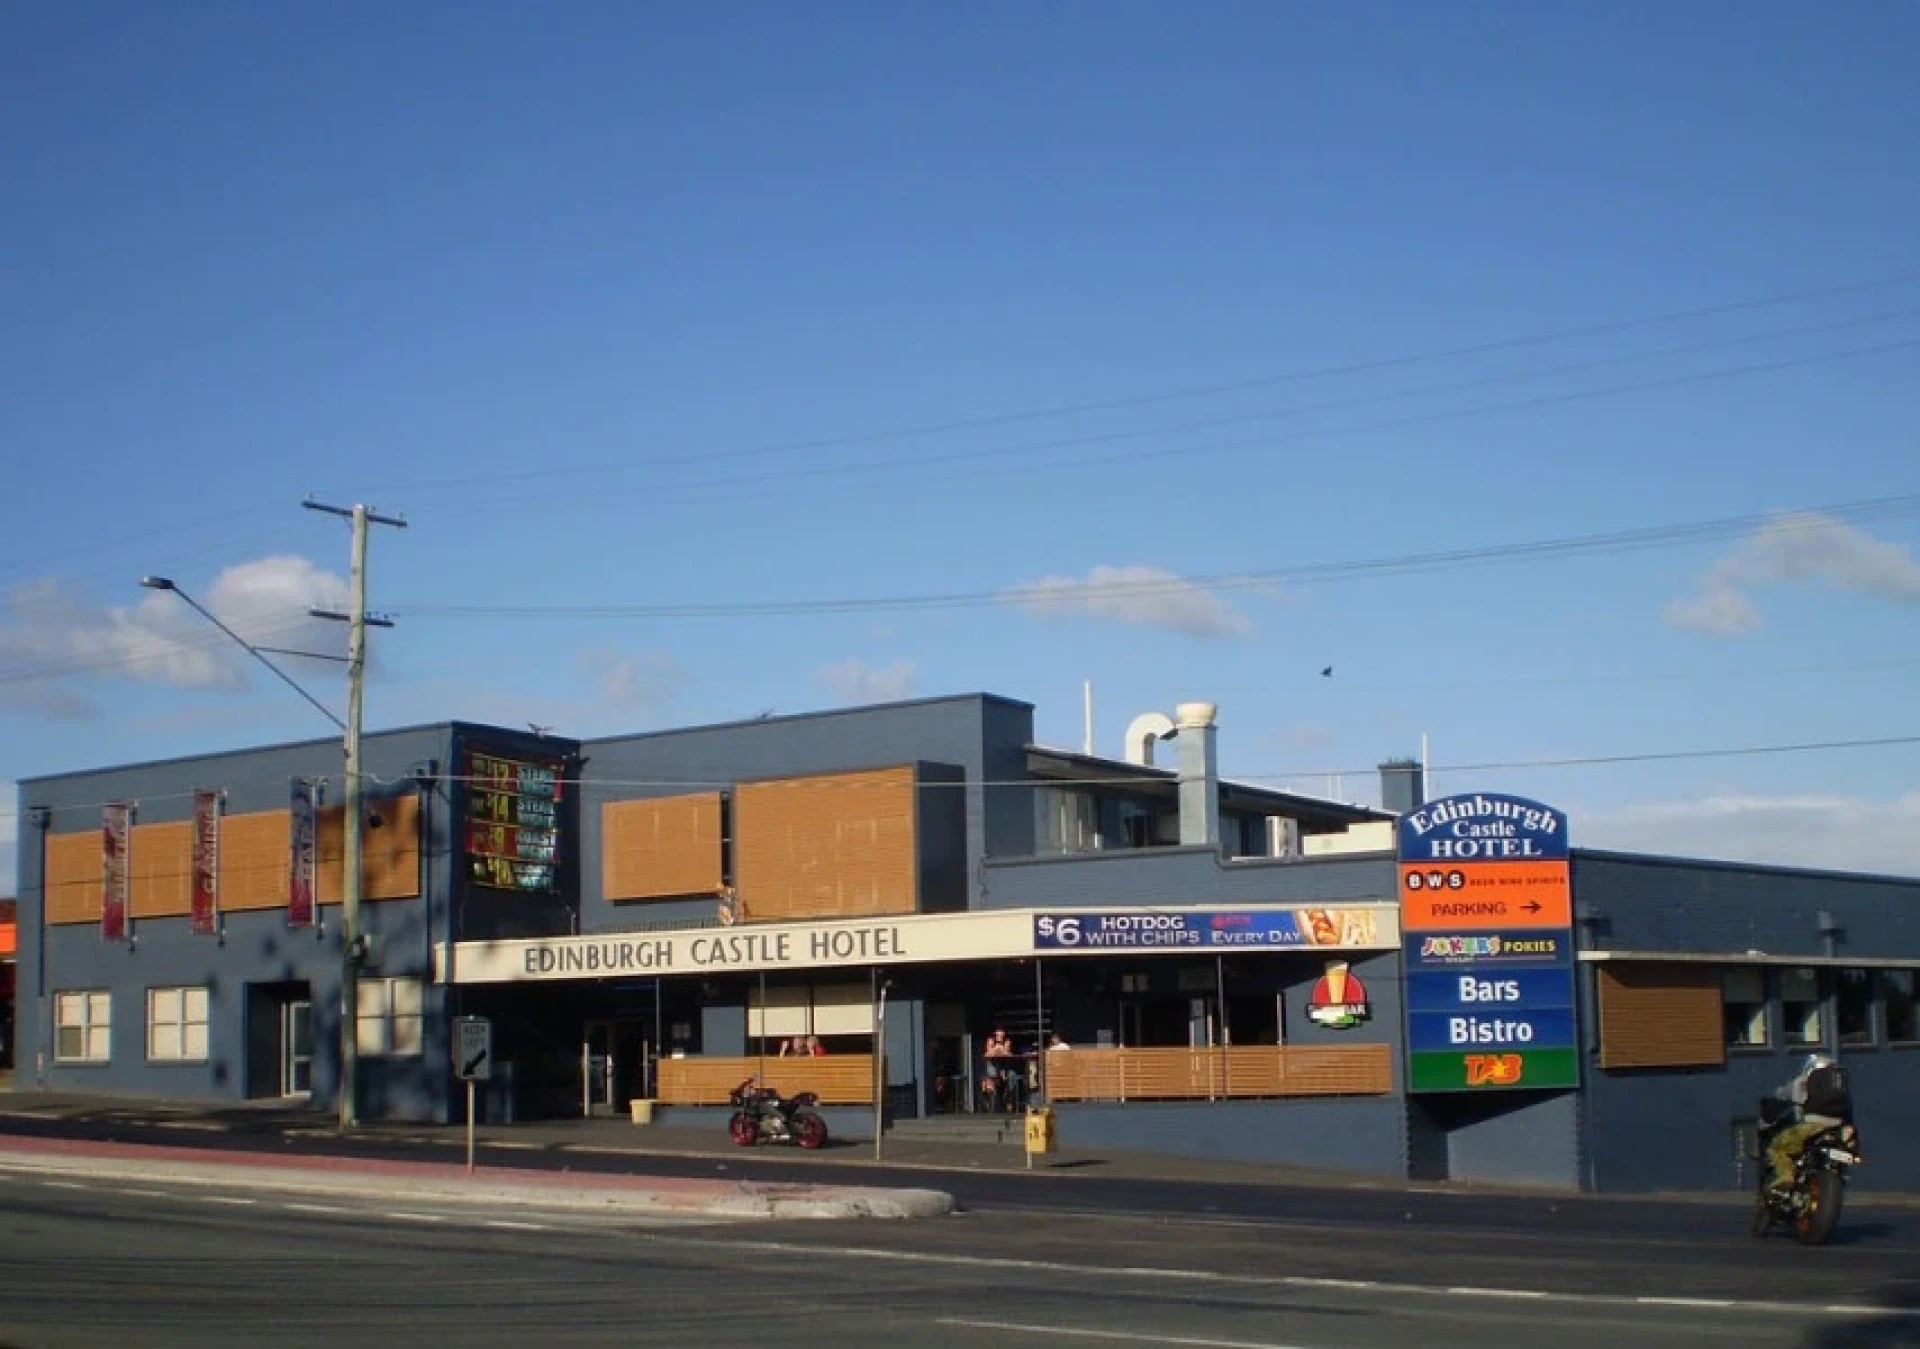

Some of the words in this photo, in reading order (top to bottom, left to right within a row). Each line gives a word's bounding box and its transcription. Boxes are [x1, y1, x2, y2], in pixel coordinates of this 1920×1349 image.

[1408, 795, 1557, 836] Edinburgh
[1453, 820, 1516, 837] Castle
[1430, 838, 1542, 857] HOTEL
[1431, 901, 1507, 916] PARKING
[1037, 916, 1081, 946] $6
[1101, 915, 1185, 930] HOTDOG
[1086, 932, 1138, 946] WITH
[1140, 931, 1201, 946] CHIPS
[524, 939, 674, 974] EDINBURGH
[690, 932, 791, 965] CASTLE
[810, 926, 907, 960] HOTEL
[1503, 939, 1556, 952] POKIES
[1458, 976, 1520, 1003] Bars
[1450, 1017, 1533, 1044] Bistro
